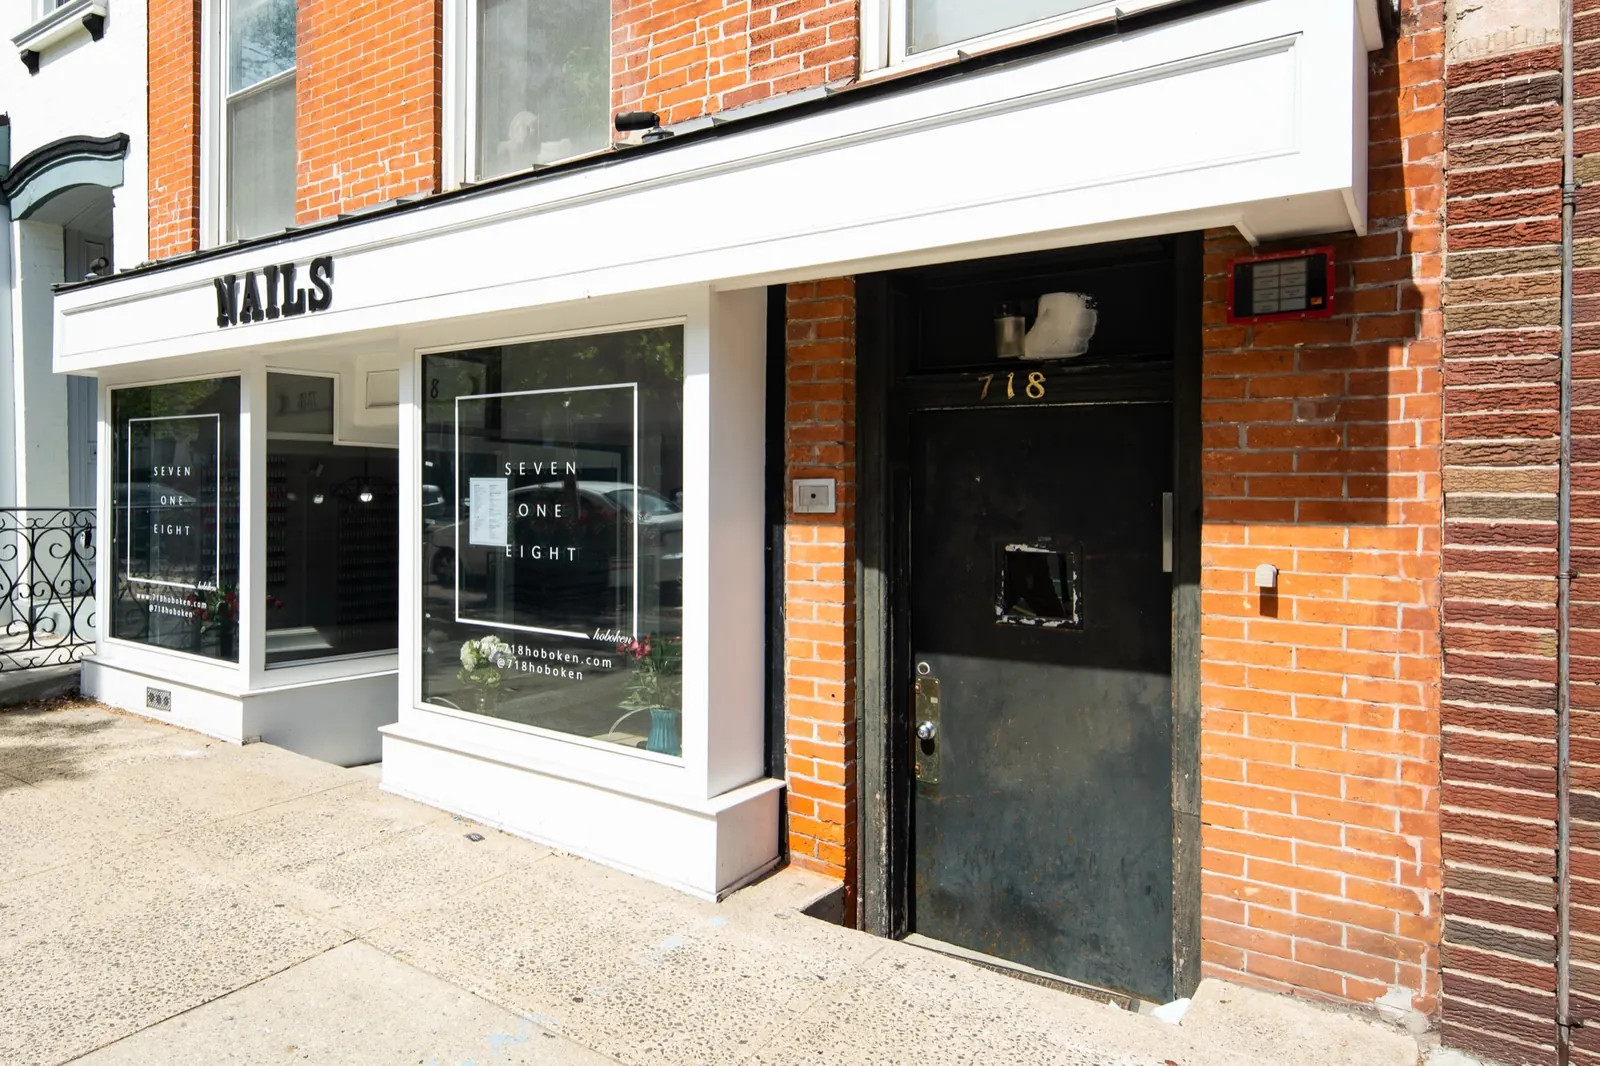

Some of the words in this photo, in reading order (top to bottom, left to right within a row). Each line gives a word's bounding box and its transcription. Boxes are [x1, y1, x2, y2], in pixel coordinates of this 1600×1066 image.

[213, 256, 333, 328] NAILS
[978, 371, 1047, 400] 718
[153, 466, 192, 477] SEVEN
[504, 461, 576, 476] SEVEN
[160, 495, 184, 507] ONE
[518, 503, 562, 518] ONE
[153, 523, 190, 536] EIGHT
[505, 543, 576, 562] EIGHT
[136, 592, 207, 609] www.718hoboken.com
[148, 603, 193, 618] @718hoboken
[592, 627, 633, 645] hoboken
[496, 657, 584, 681] @718hoboken
